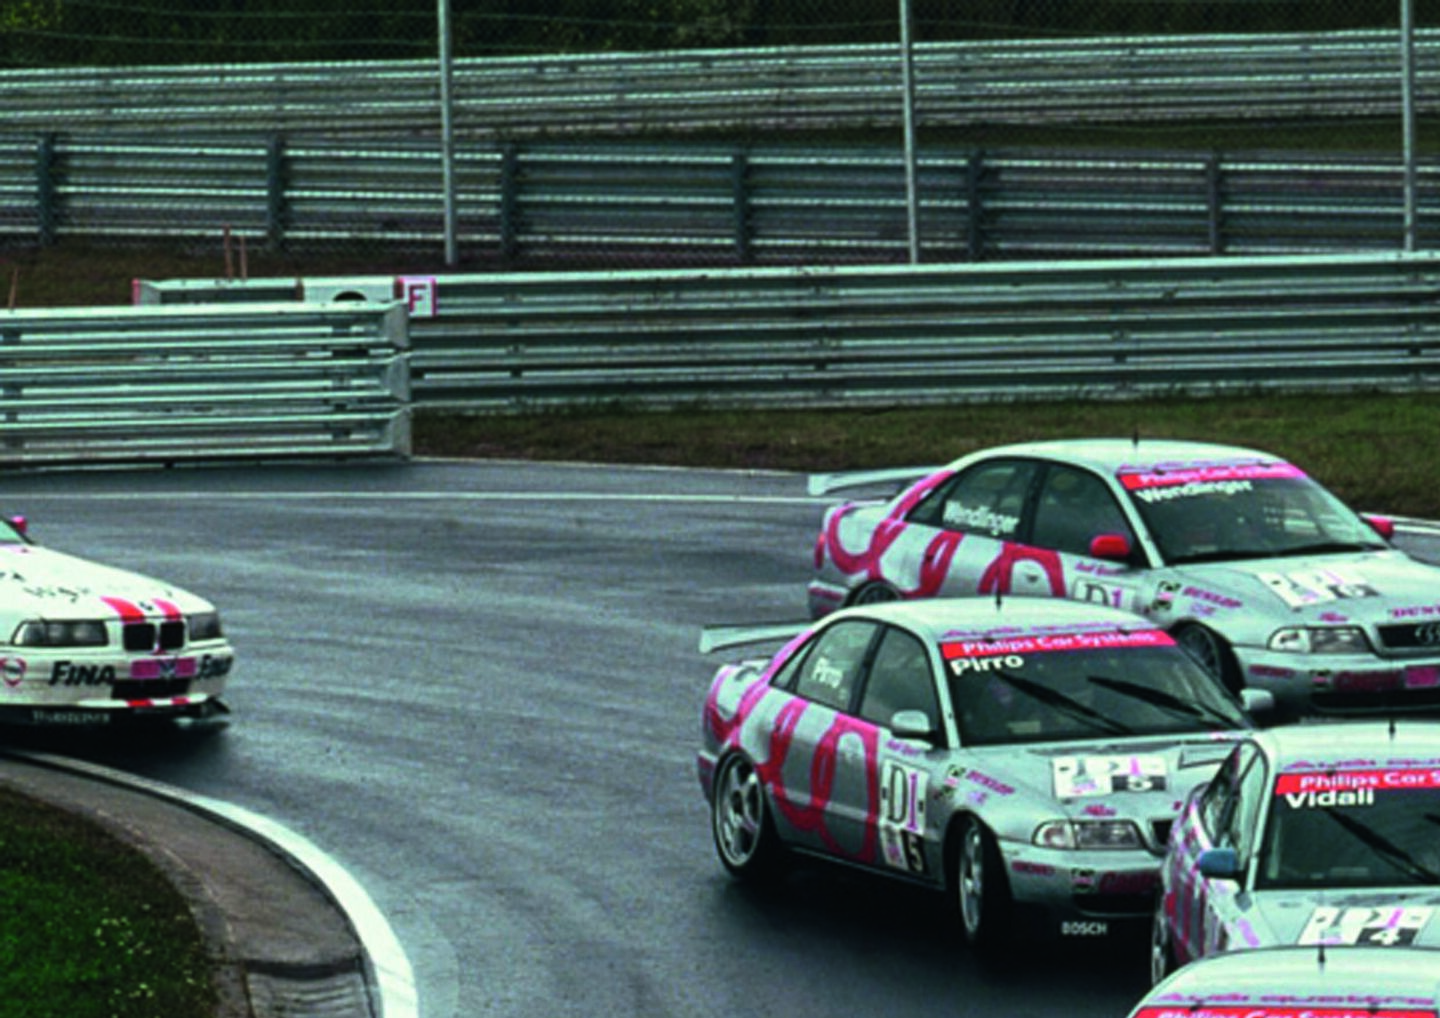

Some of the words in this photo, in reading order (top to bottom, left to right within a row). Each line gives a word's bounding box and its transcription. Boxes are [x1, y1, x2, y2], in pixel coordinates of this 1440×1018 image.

[408, 284, 427, 312] F
[1135, 480, 1253, 503] Wendlinger
[962, 638, 1035, 655] Philips
[1037, 636, 1074, 649] Car
[1078, 631, 1157, 648] Systems
[49, 660, 116, 686] FINA
[950, 654, 1024, 677] Pirro
[1300, 774, 1379, 790] Philips
[1384, 771, 1426, 785] Car
[886, 763, 918, 830] D1
[1284, 787, 1374, 809] Vidali
[906, 837, 923, 872] 5
[1061, 921, 1108, 935] BOSCH
